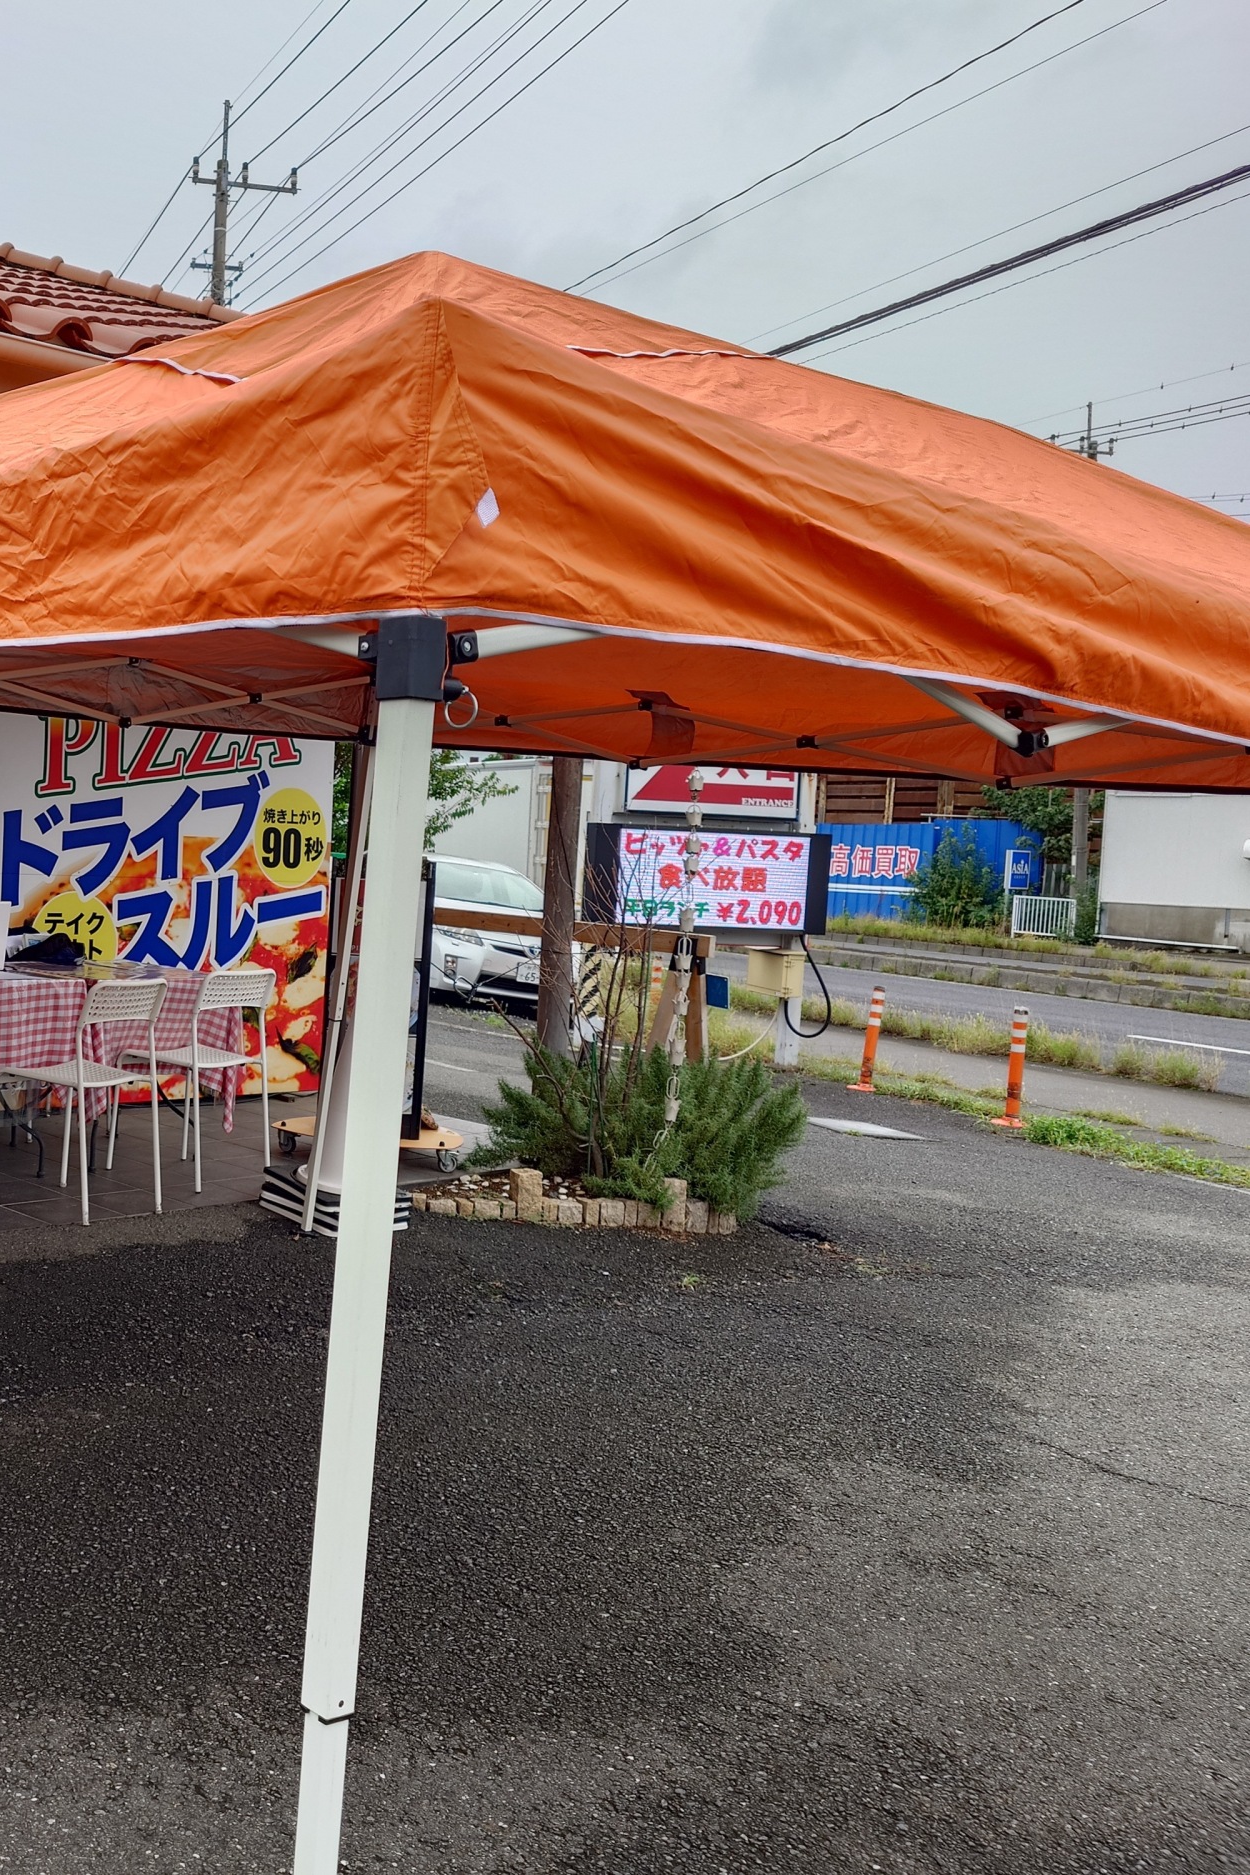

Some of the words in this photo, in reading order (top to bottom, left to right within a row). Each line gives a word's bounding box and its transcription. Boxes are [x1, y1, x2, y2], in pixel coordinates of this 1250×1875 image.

[263, 807, 321, 826] 焼き上がり
[741, 797, 794, 808] ENTRANCE
[1, 770, 270, 907] ドライブ
[829, 843, 920, 879] 高価買取
[658, 862, 768, 893] 食べ放題
[45, 912, 105, 934] テイク
[118, 875, 323, 969] スルー
